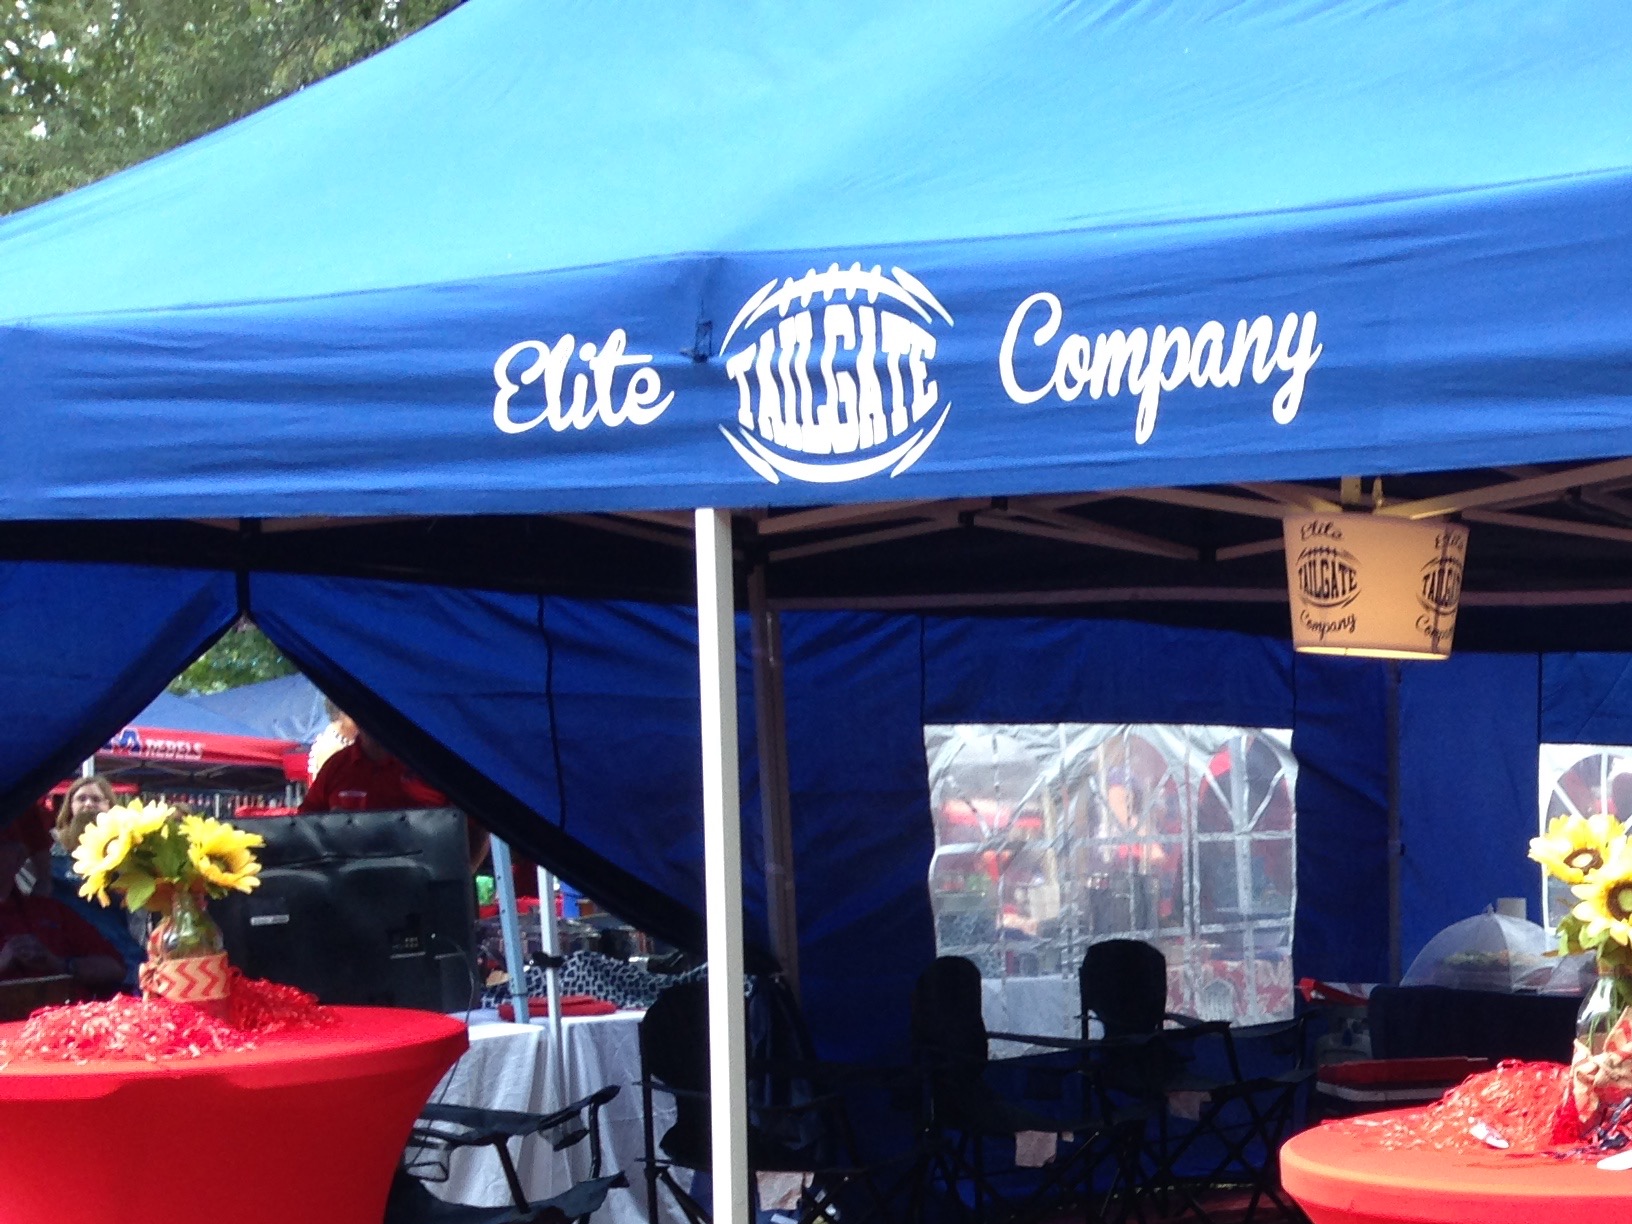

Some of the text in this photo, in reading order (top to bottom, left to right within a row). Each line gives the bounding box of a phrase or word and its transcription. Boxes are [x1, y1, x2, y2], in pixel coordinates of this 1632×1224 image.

[492, 292, 1323, 455] Elite TAILGATE Company
[1300, 520, 1343, 541] Elite
[1298, 558, 1358, 600] TAILGATE
[1300, 609, 1358, 641] Company
